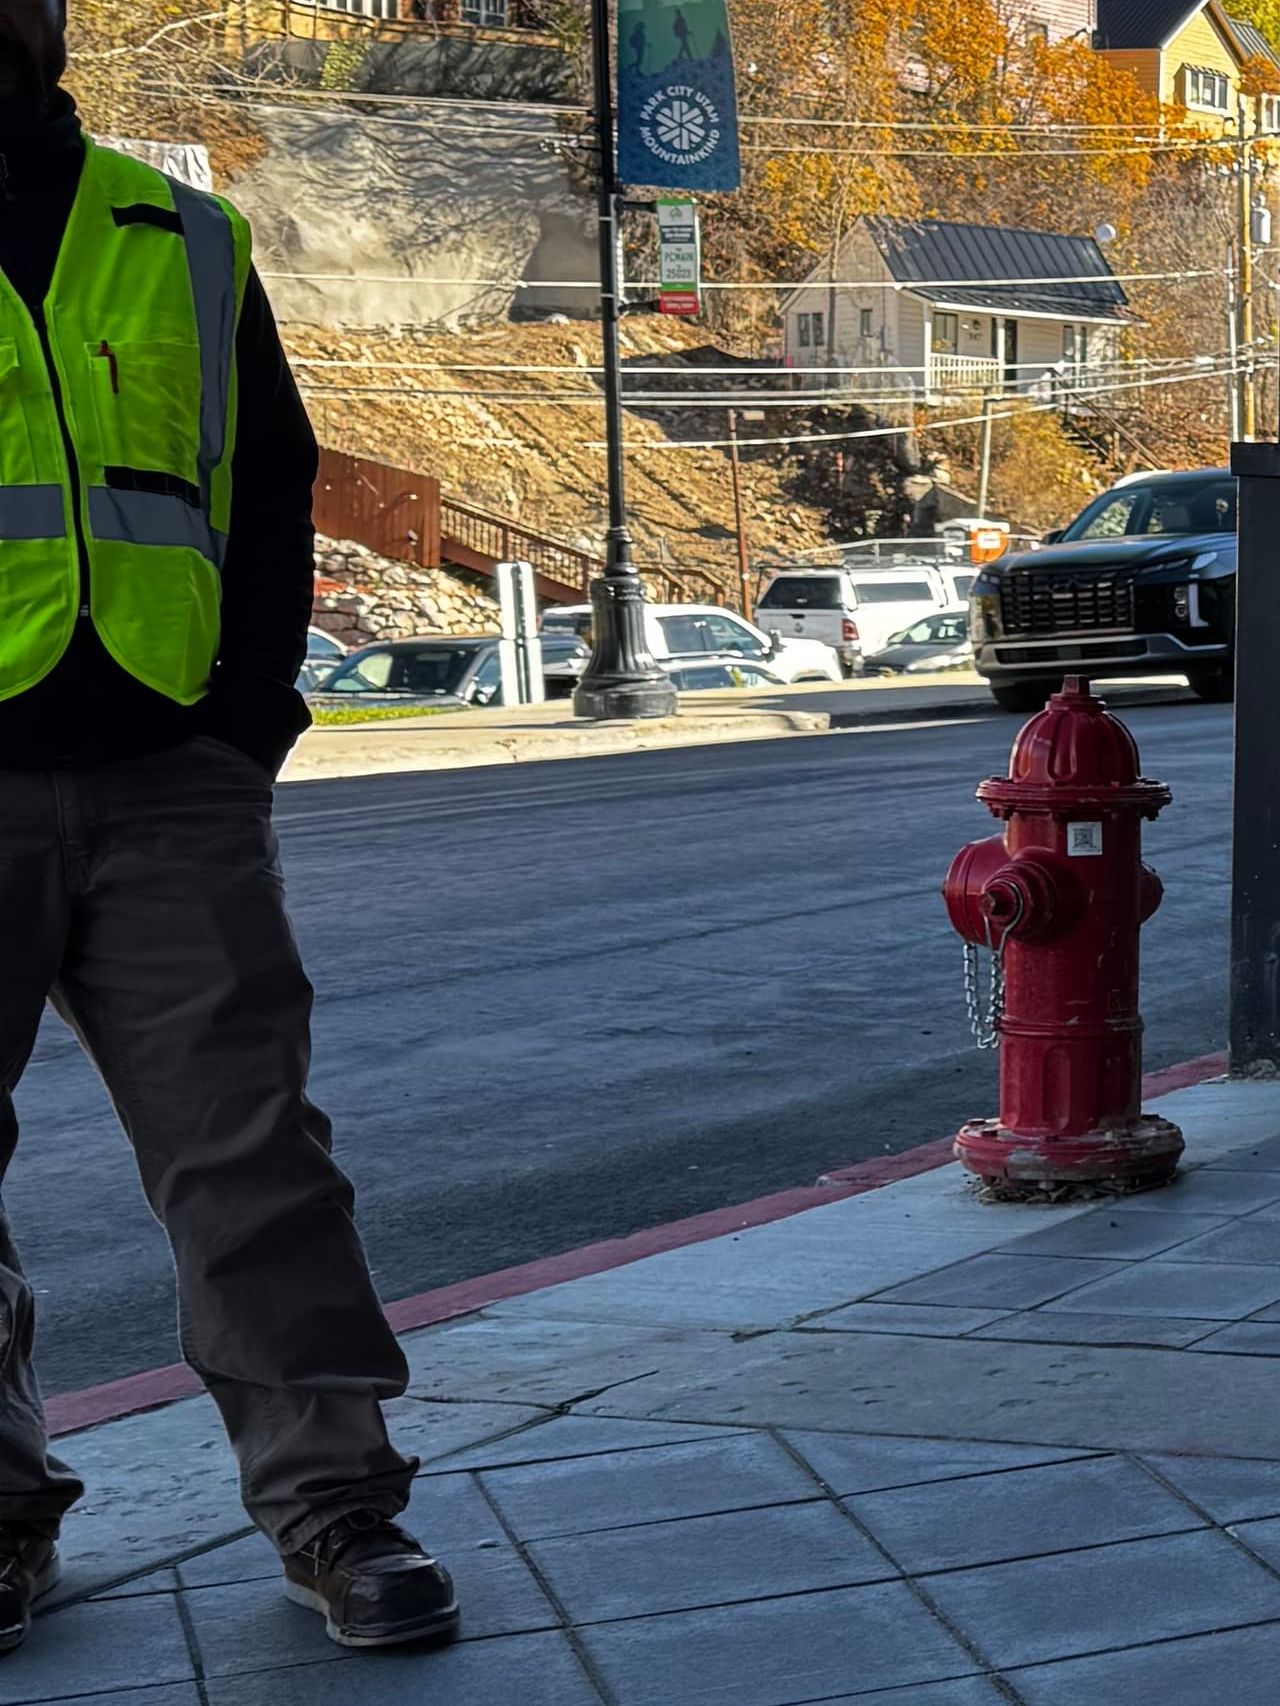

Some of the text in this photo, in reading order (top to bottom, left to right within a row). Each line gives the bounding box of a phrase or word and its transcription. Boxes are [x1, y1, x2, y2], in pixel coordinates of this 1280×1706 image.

[640, 85, 720, 123] PARK CITY UTAH
[639, 126, 720, 165] MOUNTAINKIND
